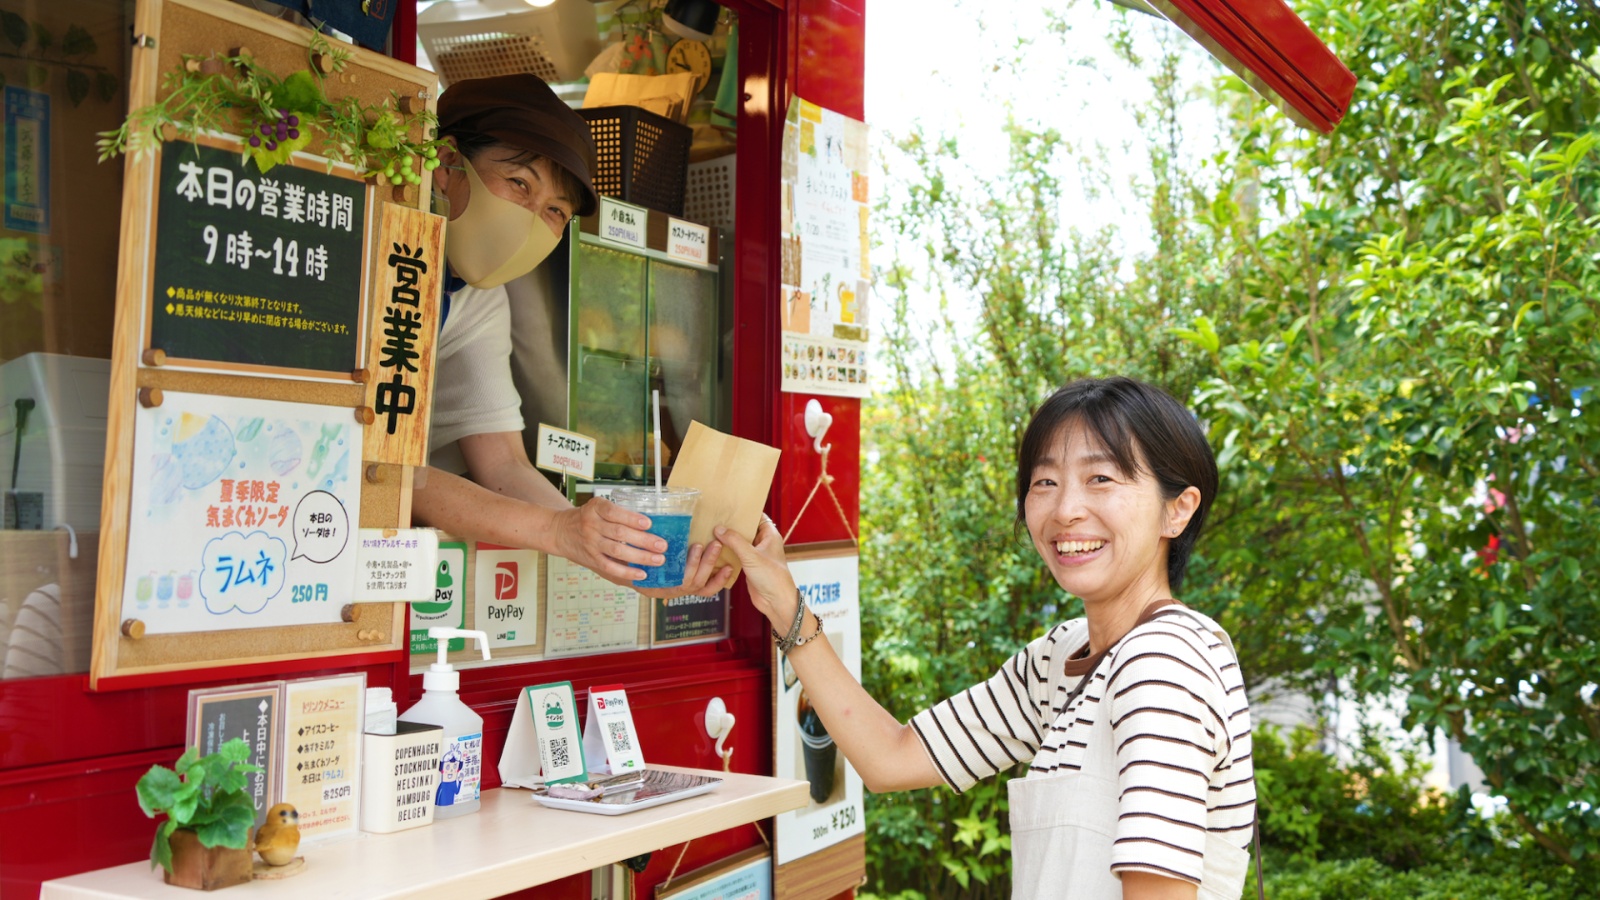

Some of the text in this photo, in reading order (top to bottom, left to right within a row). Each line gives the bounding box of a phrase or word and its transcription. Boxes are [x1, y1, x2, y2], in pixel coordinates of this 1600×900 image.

[176, 160, 353, 232] 本日の営業時間
[375, 242, 428, 435] 営業中
[547, 433, 590, 456] チーズボロネーゼ
[220, 479, 281, 504] 夏季限定
[206, 505, 289, 528] 気まぐれソーダ
[309, 513, 332, 524] 本日の
[215, 550, 275, 593] ラムネ
[488, 604, 525, 622] PayPay
[302, 699, 345, 712] ドリンクメニュー
[605, 698, 624, 707] PayPay
[304, 723, 340, 736] アイスコーヒー
[303, 740, 335, 753] あずきミルク
[395, 743, 439, 760] COPENHAGEN
[303, 756, 340, 770] 気まぐれソーダ
[394, 758, 438, 776] STOCKHOLM
[396, 774, 433, 791] HELSINKI
[323, 786, 351, 801] 各250円
[396, 790, 430, 807] HAMBURG
[831, 805, 856, 831] ¥250
